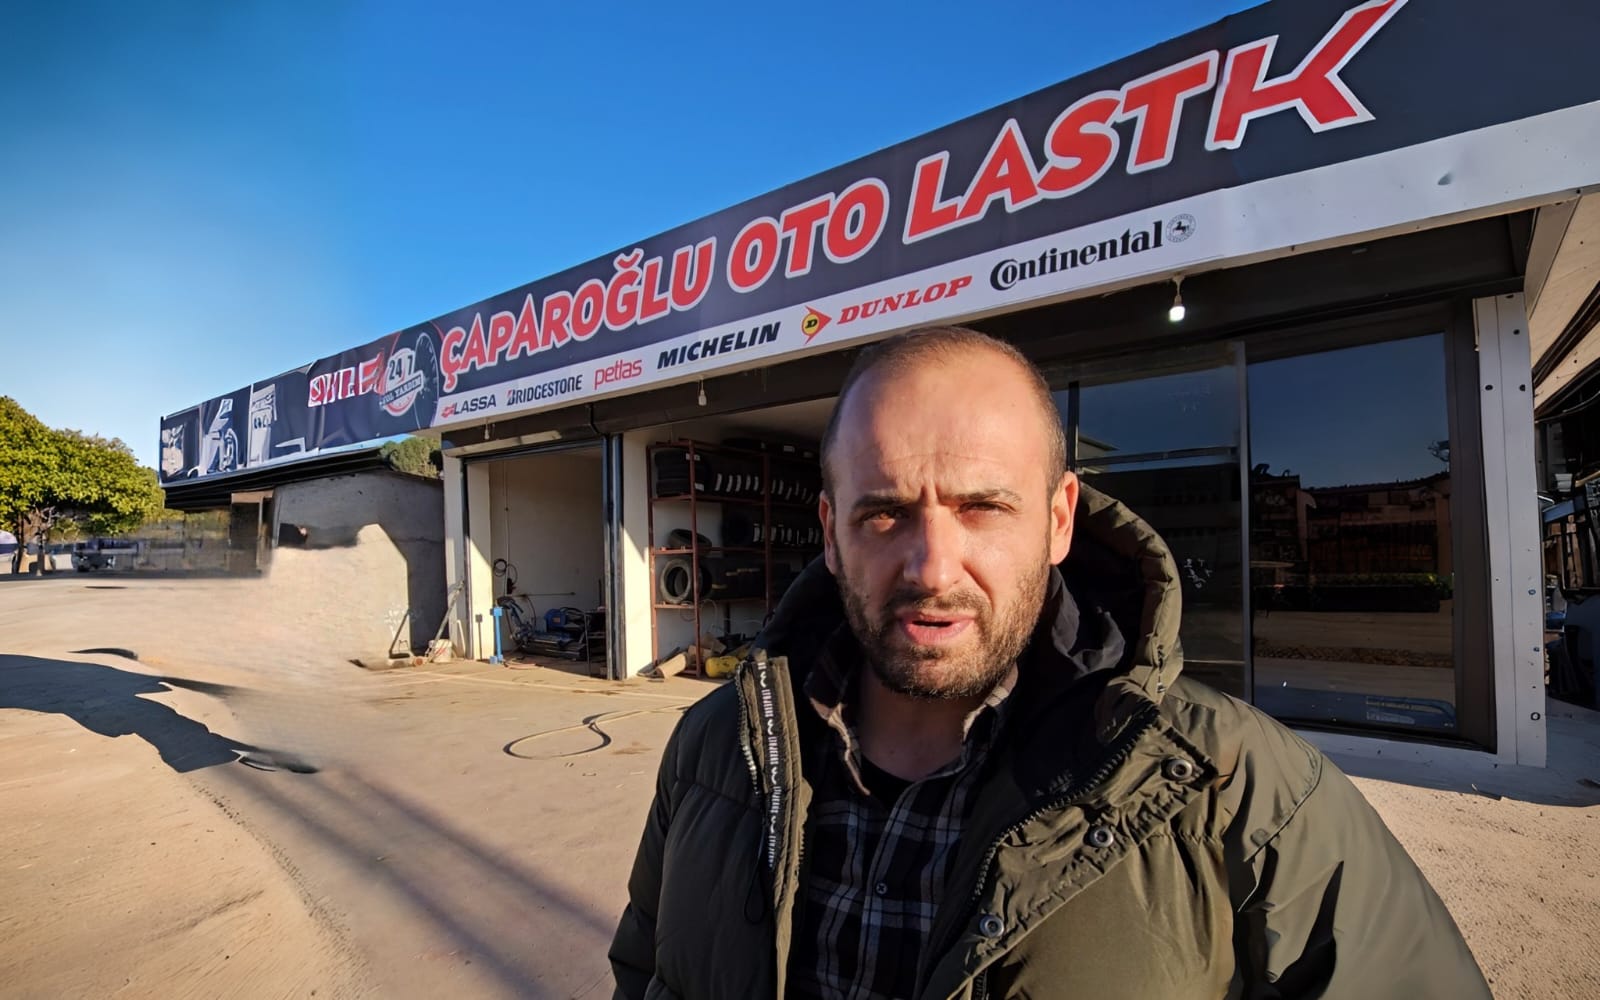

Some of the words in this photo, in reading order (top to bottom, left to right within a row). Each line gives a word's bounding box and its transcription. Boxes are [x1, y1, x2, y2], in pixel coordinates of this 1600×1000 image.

[990, 220, 1163, 291] Continental
[440, 238, 716, 391] ÇAPAROĞLU
[727, 178, 889, 294] OTO
[837, 275, 972, 325] DUNLOP
[657, 321, 781, 369] MICHELIN
[506, 374, 583, 406] BRIDGESTONE
[594, 359, 643, 390] petlas
[453, 394, 497, 415] LASSA
